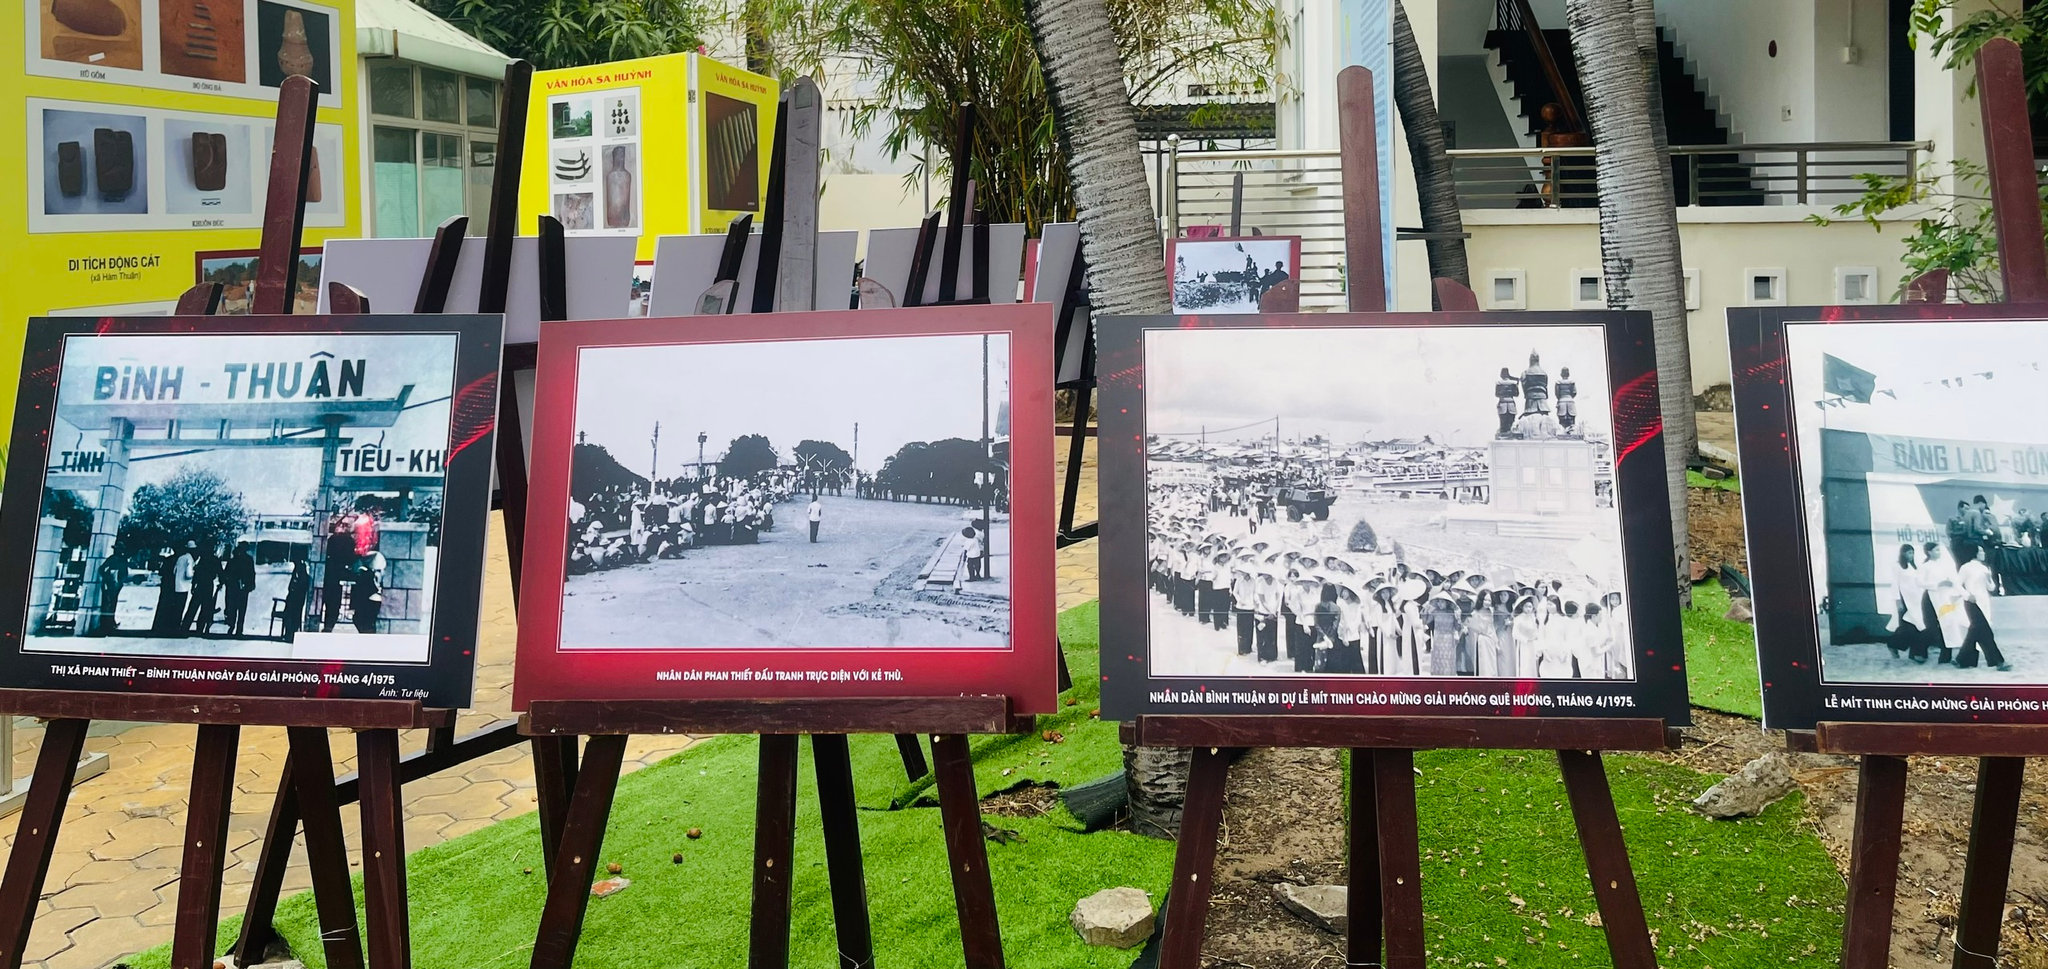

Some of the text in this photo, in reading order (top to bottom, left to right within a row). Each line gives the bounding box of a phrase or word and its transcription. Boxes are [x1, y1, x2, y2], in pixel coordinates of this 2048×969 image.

[546, 69, 652, 90] VĂN HÓA SA HUỲNH
[68, 259, 79, 271] DI
[82, 256, 106, 270] TÍCH
[51, 665, 66, 677] THỊ
[67, 664, 81, 675] XÃ
[82, 666, 109, 677] PHAN
[111, 665, 137, 678] THIẾT
[146, 666, 170, 679] BÌNH
[172, 668, 205, 682] THUẬN
[206, 668, 234, 681] NGÀY
[236, 671, 258, 682] ĐẦU
[259, 671, 281, 682] GIẢI
[282, 671, 321, 685] PHÓNG,
[324, 672, 360, 684] THÁNG
[361, 673, 395, 687] 4/1975
[656, 668, 904, 684] NHÂN DÂN PHAN THIẾT ĐẤU TRANH TRỰC DIỆN VỚI KẺ THÙ.
[401, 688, 413, 698] Tư
[413, 688, 429, 700] liệu
[1149, 688, 1636, 708] NHÂN DÂN BÌNH THUẬN ĐI DỰ LỄ MÍT TINH CHÀO MỪNG GIẢI PHÓNG QUÊ HƯƠNG, THÁNG 4/1975.
[1825, 693, 1838, 708] LỄ
[1841, 695, 1862, 709] MÍT
[1864, 698, 1892, 709] TINH
[1894, 697, 1929, 710] CHÀO
[1931, 696, 1968, 711] MỪNG
[1970, 697, 1995, 711] GIẢI
[1997, 698, 2040, 711] PHÓNG
